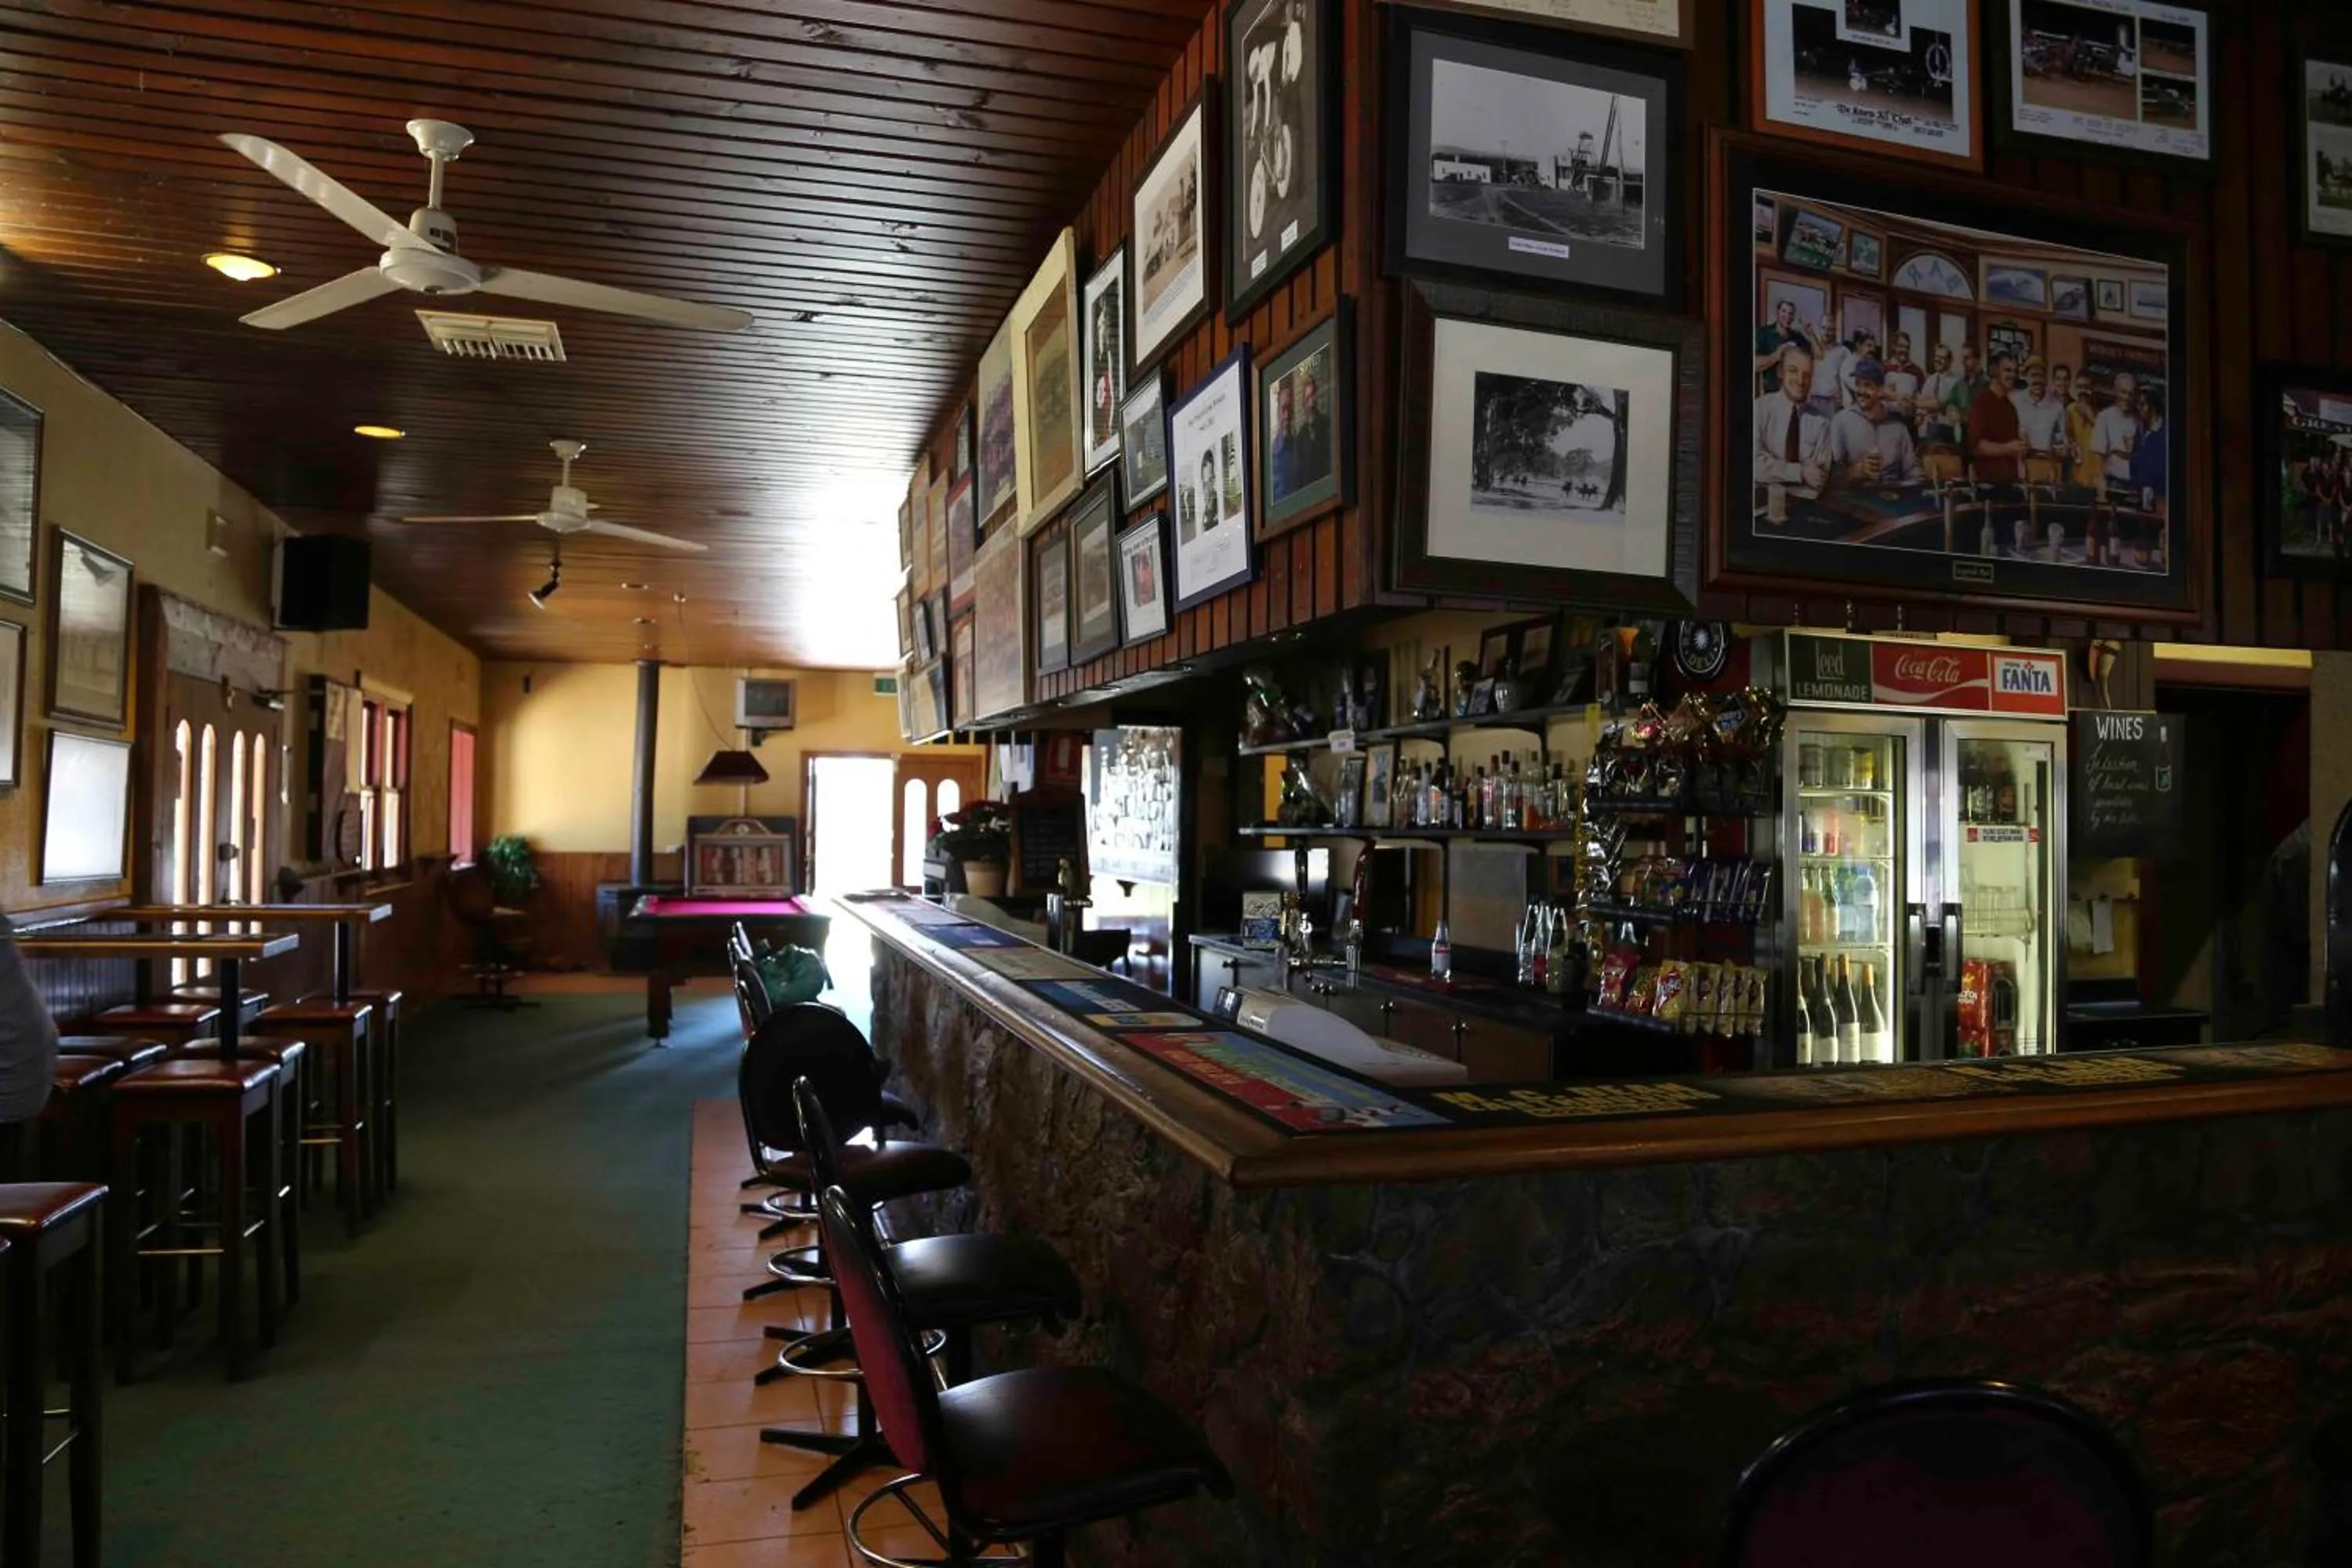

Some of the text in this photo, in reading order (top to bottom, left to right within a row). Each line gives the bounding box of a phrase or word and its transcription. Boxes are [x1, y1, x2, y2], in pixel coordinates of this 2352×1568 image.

[1796, 682, 1869, 701] LEMONADE
[2002, 668, 2052, 692] FANTA
[2096, 714, 2144, 741] WINES
